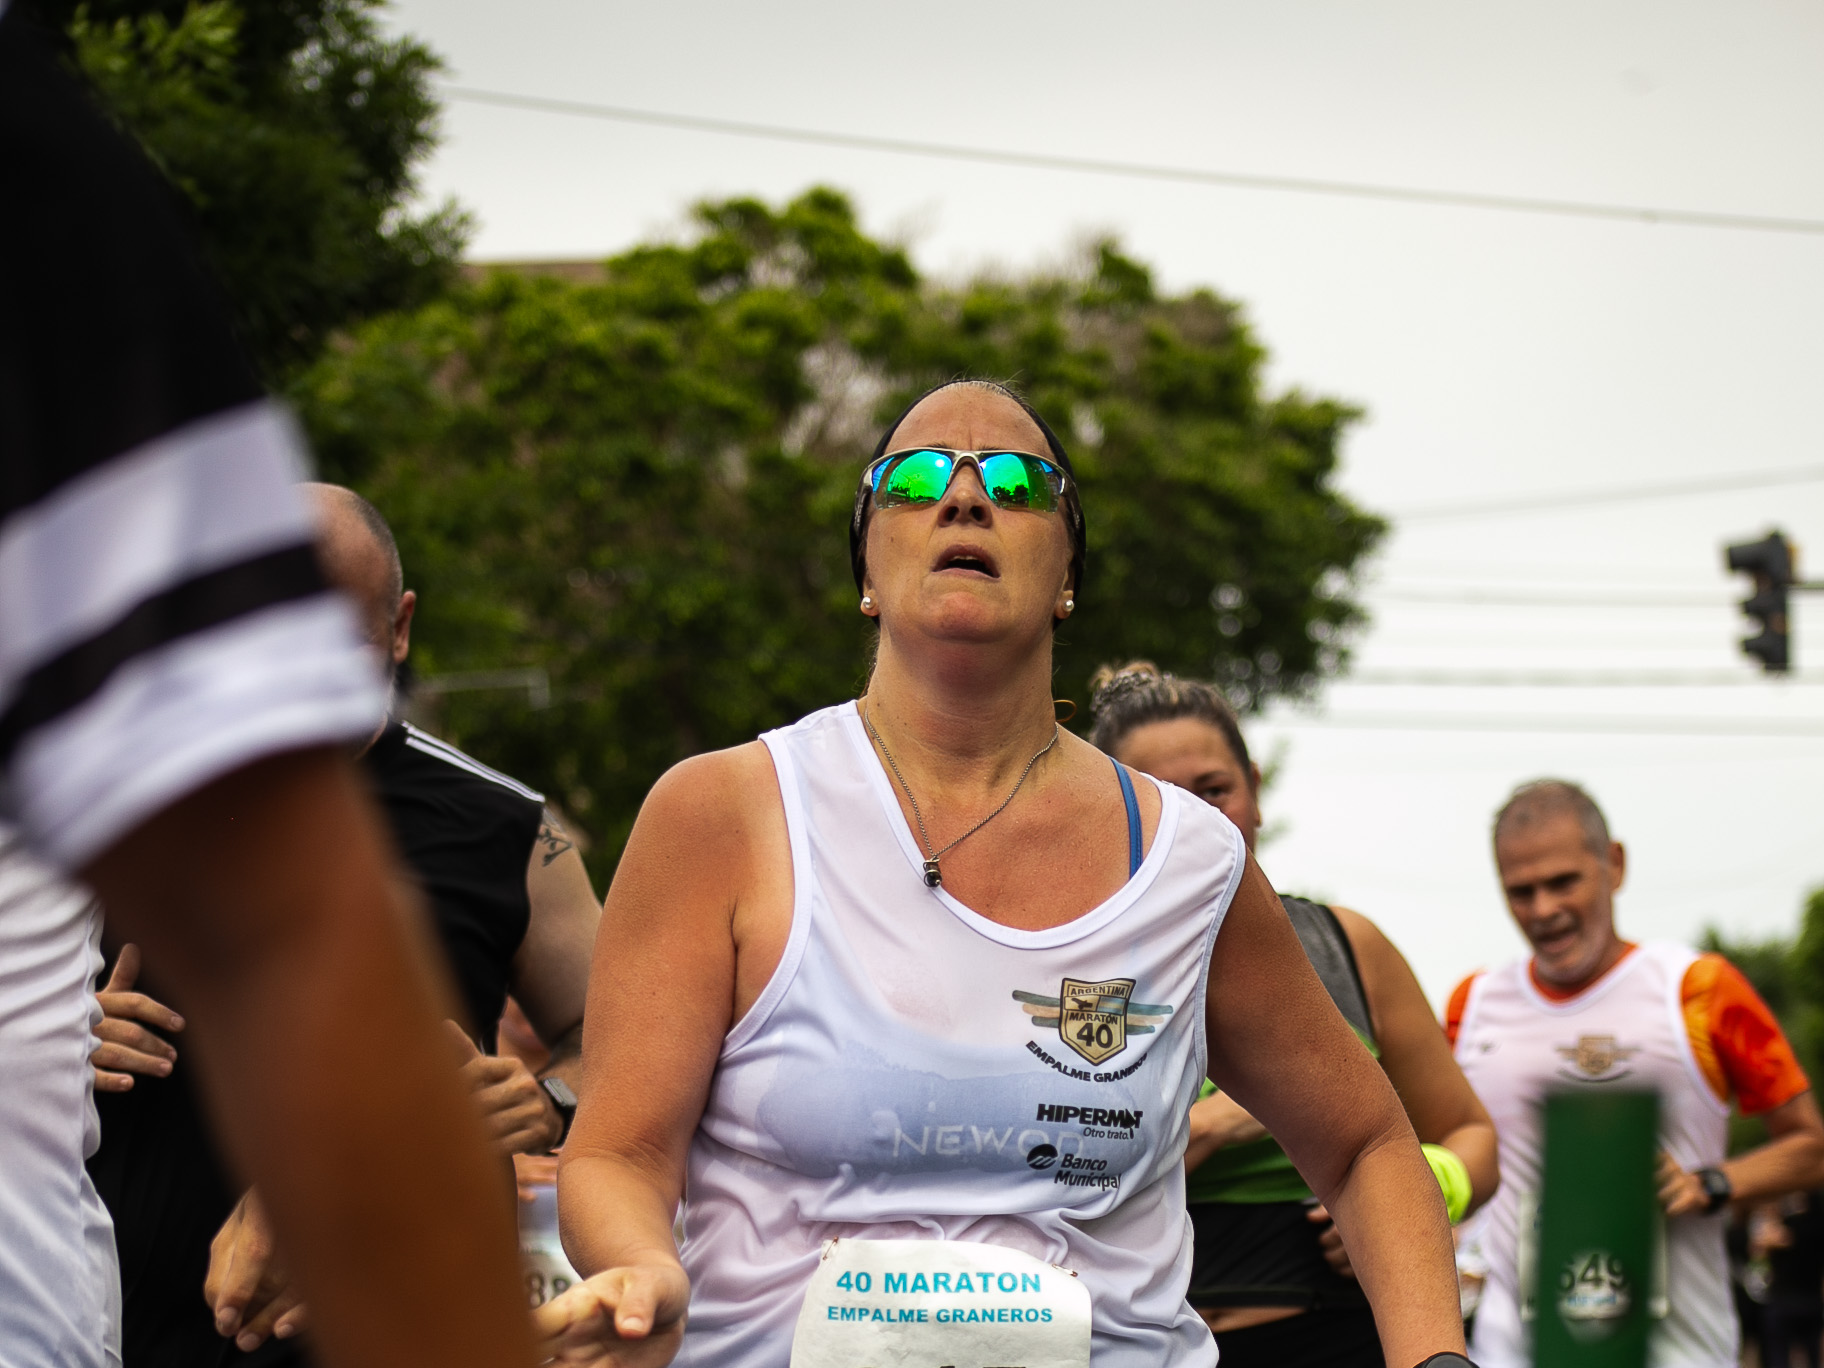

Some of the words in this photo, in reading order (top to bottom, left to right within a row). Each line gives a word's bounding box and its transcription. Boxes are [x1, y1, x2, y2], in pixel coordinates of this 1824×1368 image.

[1070, 985, 1126, 996] ARGENTINA
[1076, 1022, 1113, 1049] 40
[1025, 1040, 1091, 1081] EMPALME
[1083, 1127, 1105, 1139] Otro
[1061, 1153, 1108, 1171] Banco
[1054, 1170, 1121, 1191] Municipal
[836, 1271, 872, 1293] 40
[884, 1271, 1041, 1294] MARATON
[827, 1305, 929, 1323] EMPALME
[936, 1307, 1053, 1323] GRANEROS
